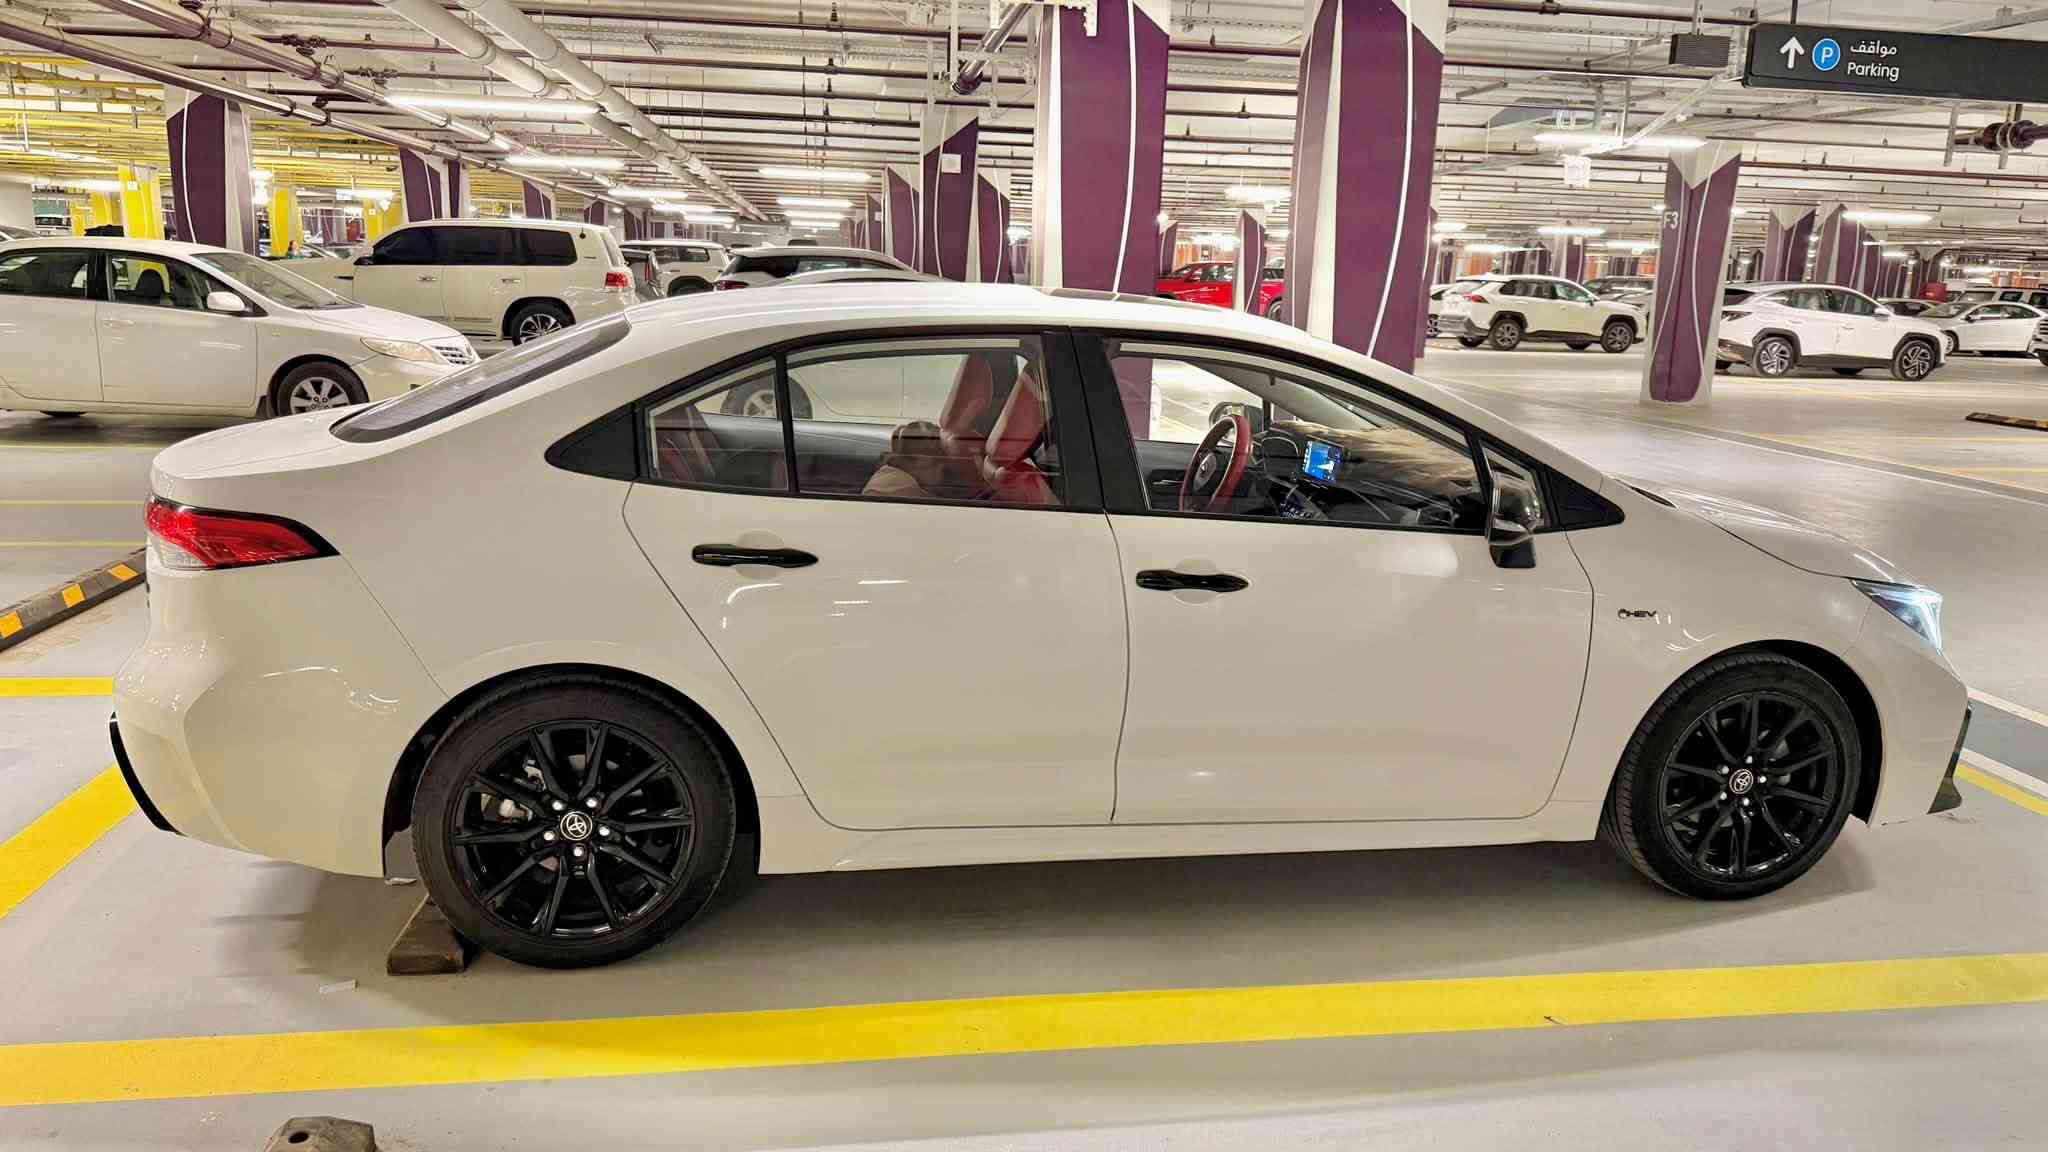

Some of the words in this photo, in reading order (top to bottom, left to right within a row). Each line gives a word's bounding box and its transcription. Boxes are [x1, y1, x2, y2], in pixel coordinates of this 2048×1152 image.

[1821, 47, 1834, 64] P
[1850, 40, 1897, 57] مواقف
[1847, 62, 1900, 81] Parking
[1663, 211, 1679, 230] F3
